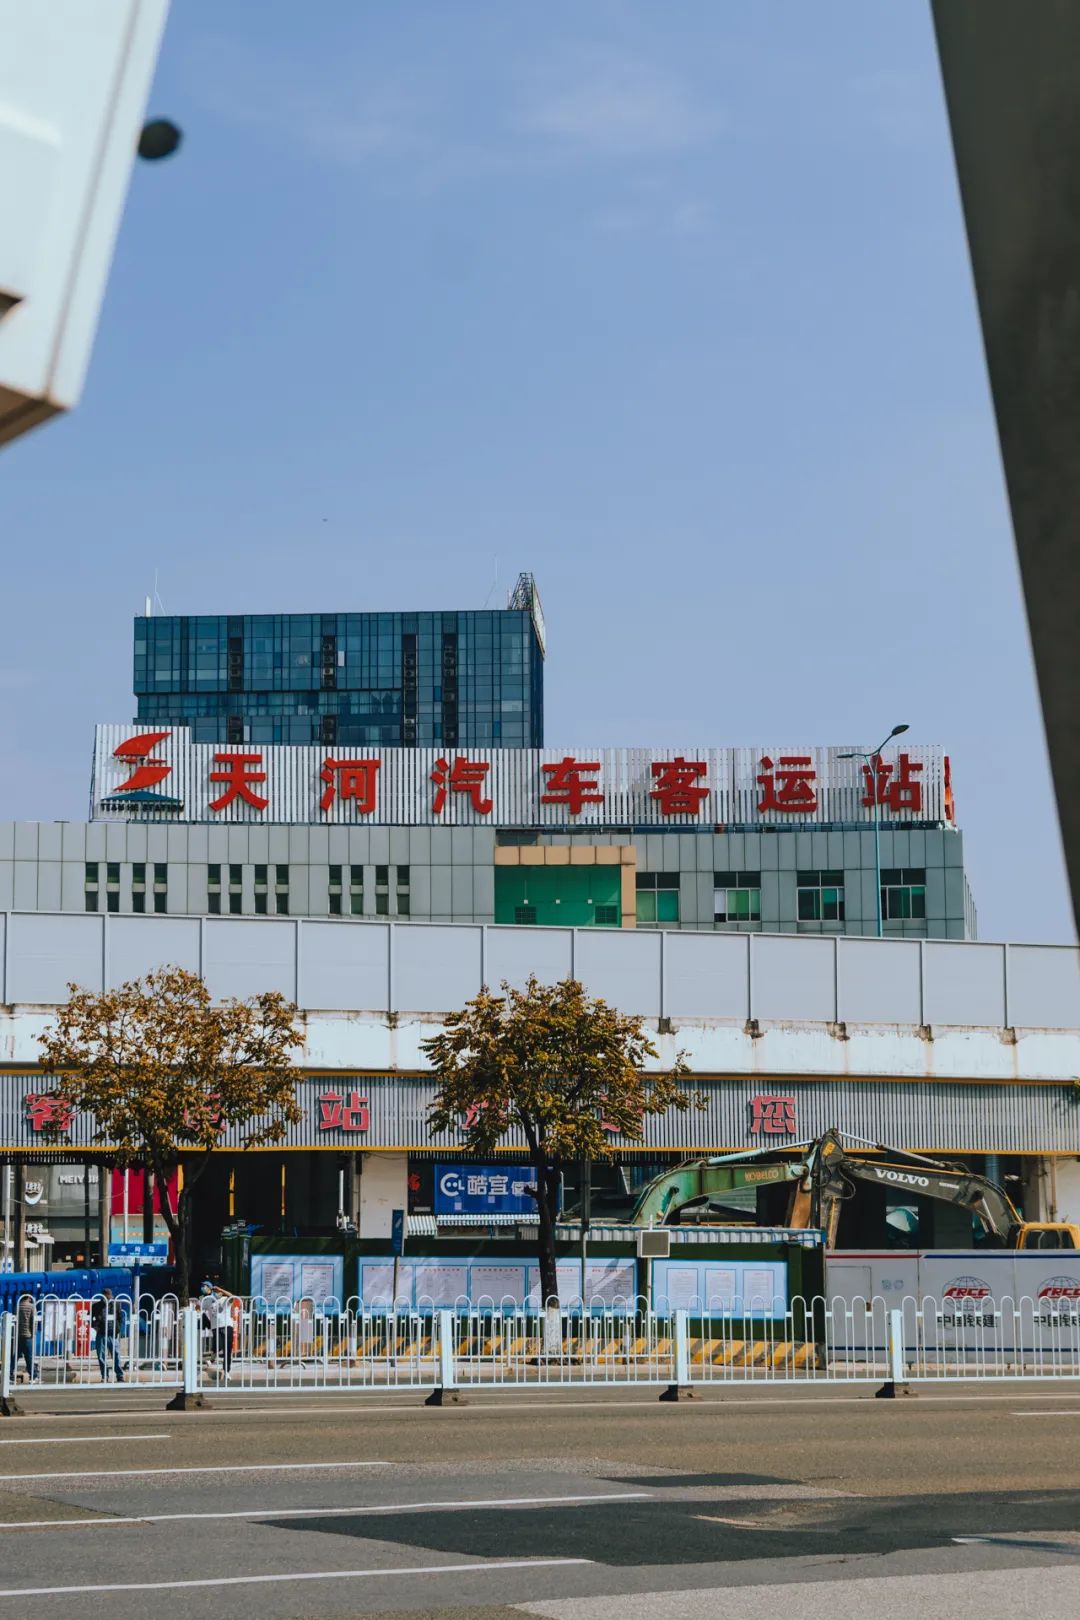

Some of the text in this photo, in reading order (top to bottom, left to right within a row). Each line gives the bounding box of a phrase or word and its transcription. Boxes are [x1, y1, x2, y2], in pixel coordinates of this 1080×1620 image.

[208, 753, 923, 815] 天河汽车客运站
[874, 1168, 930, 1187] VOLVO
